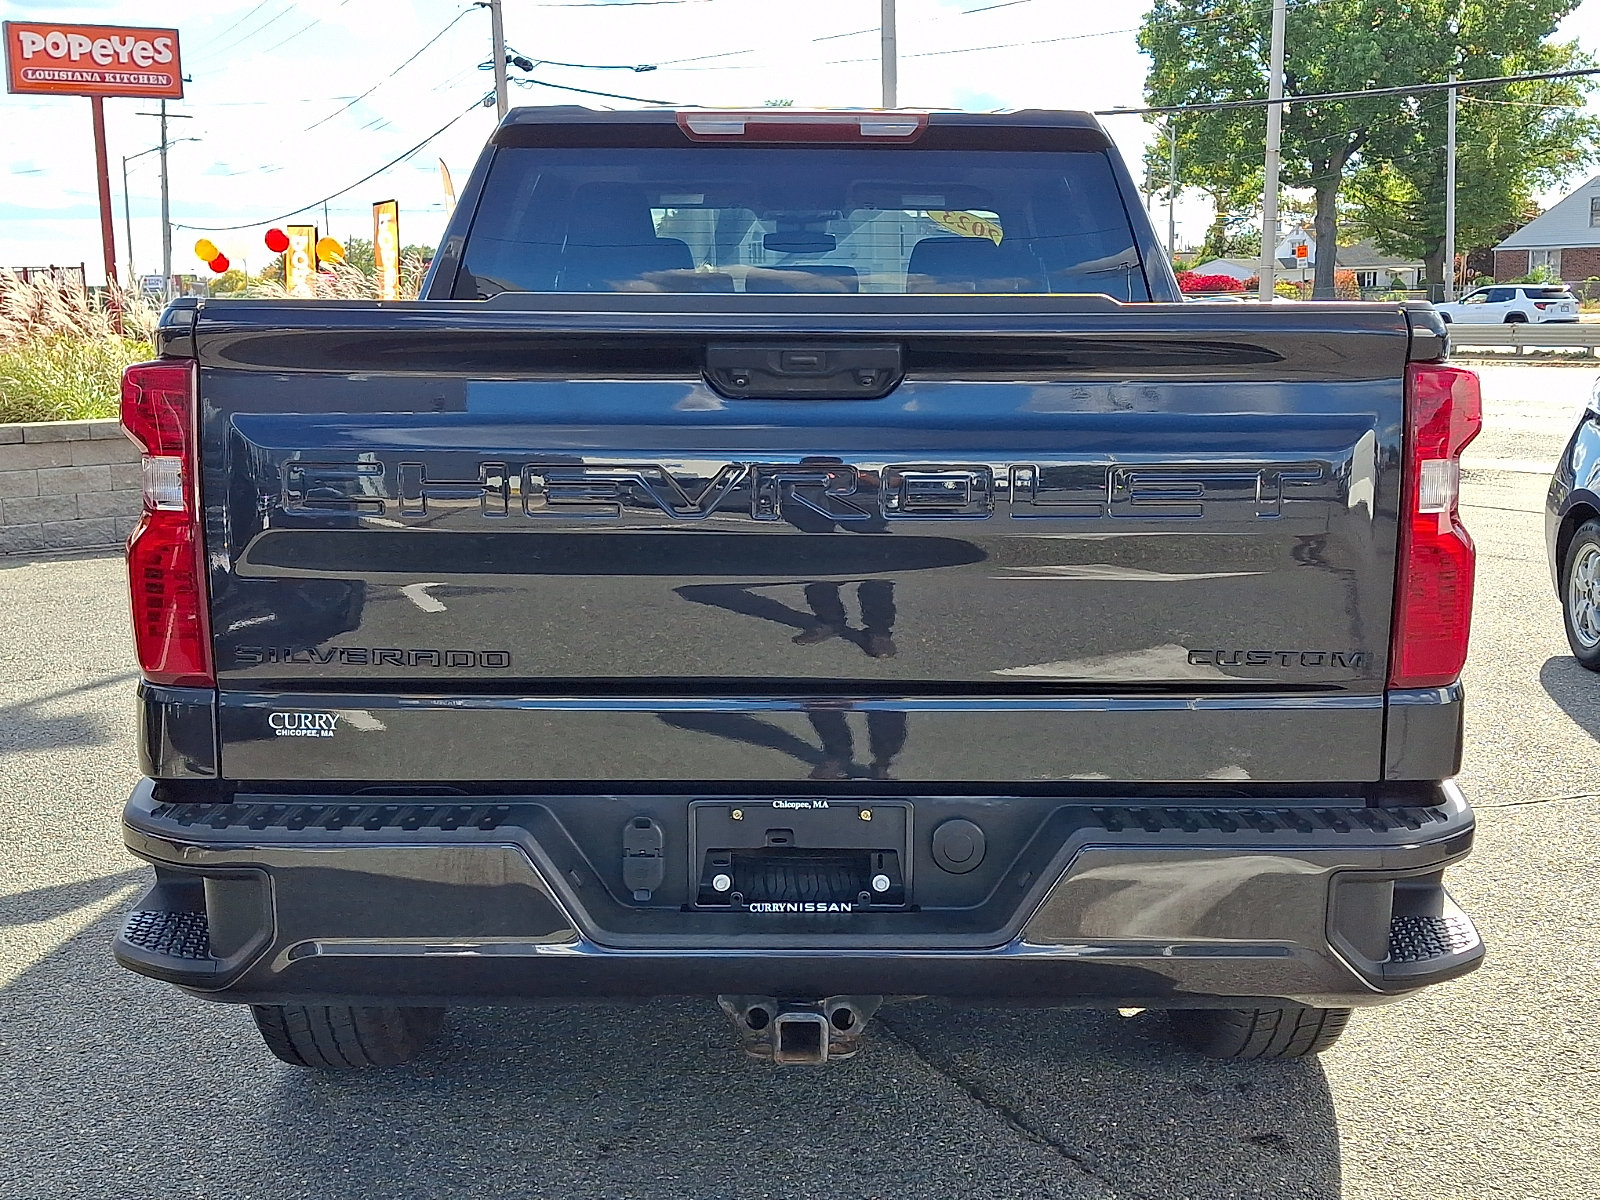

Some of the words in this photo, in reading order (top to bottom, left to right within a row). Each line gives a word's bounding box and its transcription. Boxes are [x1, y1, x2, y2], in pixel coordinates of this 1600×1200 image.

[27, 69, 102, 82] LOUISIANA
[105, 73, 168, 85] KITCHEN
[281, 459, 1325, 521] CHEVROLET
[235, 645, 511, 669] SILVERADO
[1187, 649, 1369, 668] CUSTOM
[268, 712, 340, 730] CURRY
[275, 729, 319, 738] CHICOPEE,
[772, 800, 811, 810] Chicopee,
[813, 800, 829, 809] MA
